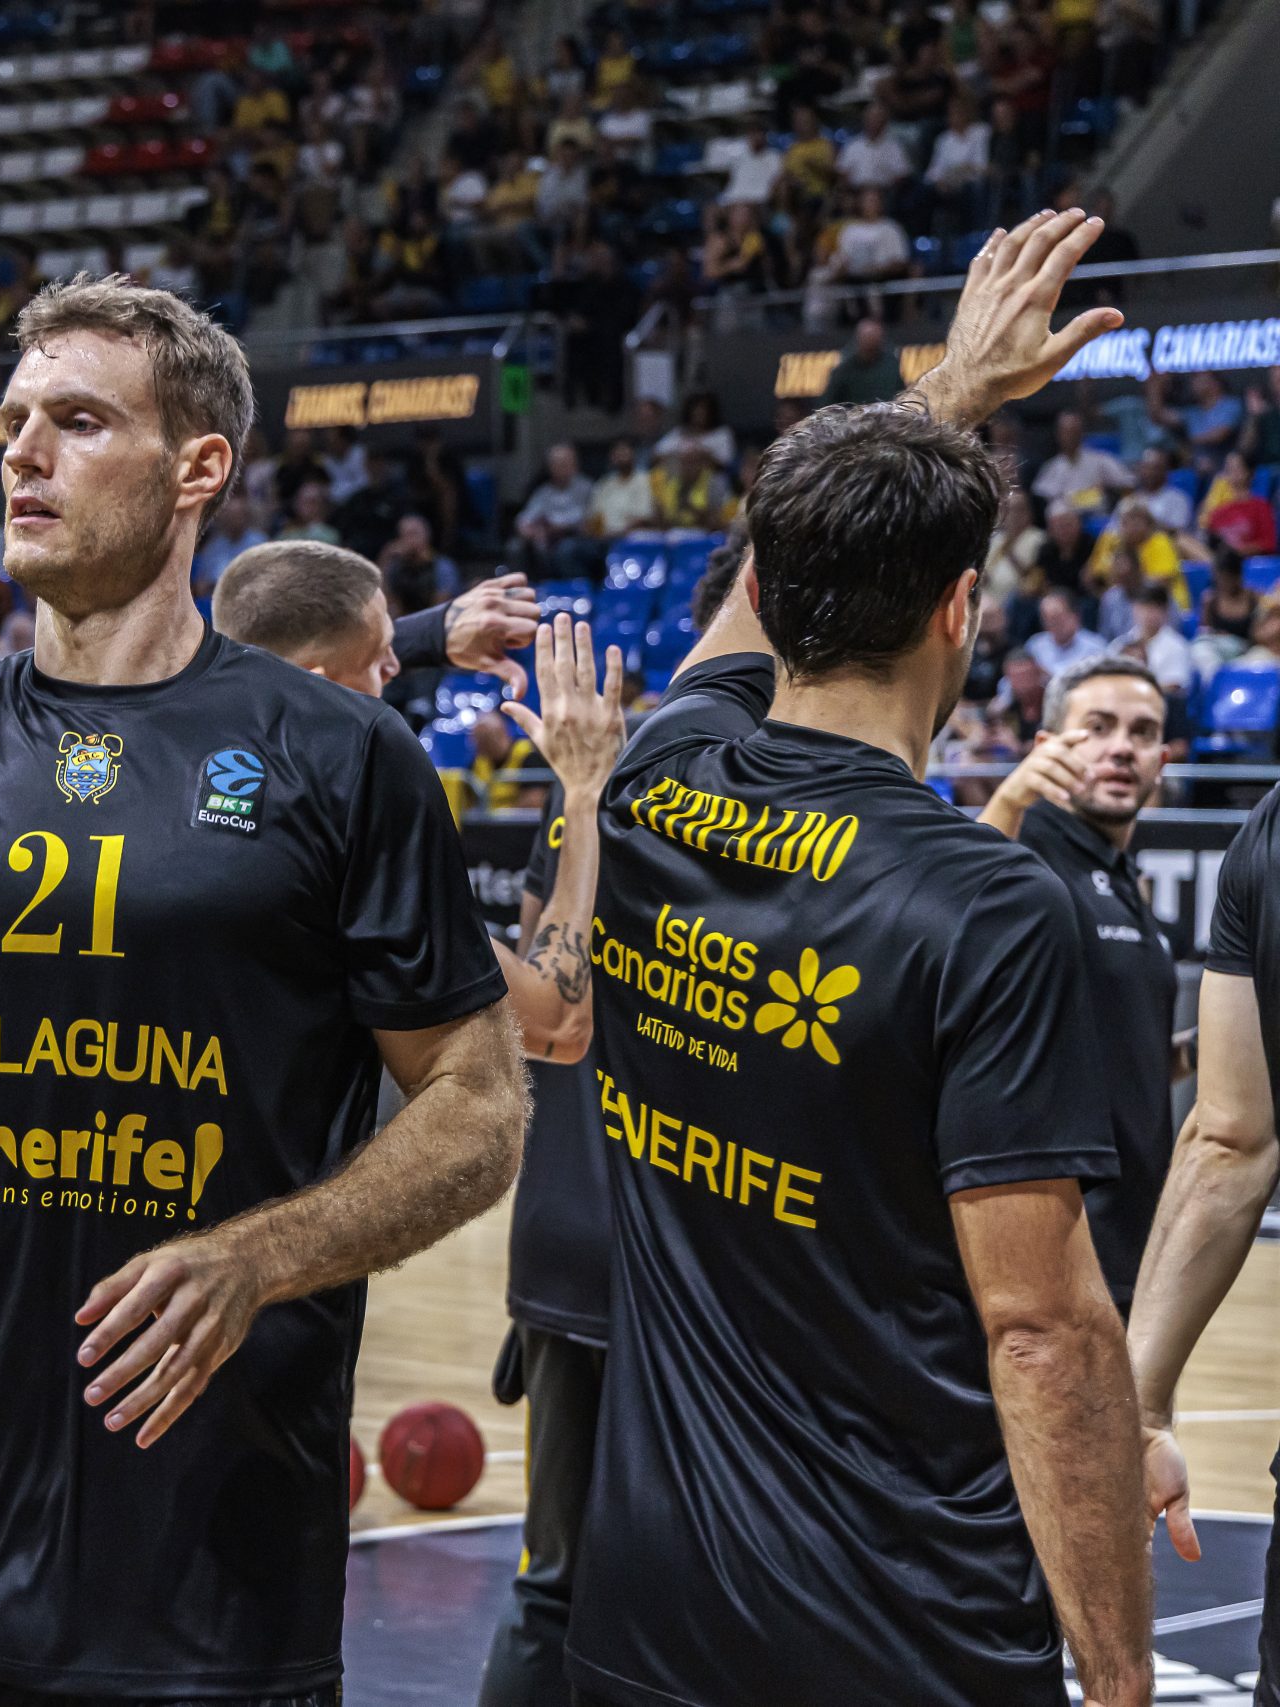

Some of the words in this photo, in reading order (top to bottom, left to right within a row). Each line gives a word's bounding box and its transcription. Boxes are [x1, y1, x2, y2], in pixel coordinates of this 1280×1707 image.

[198, 809, 256, 832] EuroCup
[207, 795, 253, 813] BKT
[630, 777, 859, 881] FITIPALDO
[1, 830, 125, 957] 21
[590, 916, 750, 1030] Canarias
[656, 904, 759, 981] Islas
[637, 1012, 685, 1051] LATITUD
[688, 1036, 706, 1060] DE
[708, 1043, 738, 1072] VIDA
[596, 1068, 823, 1229] ENERIFE
